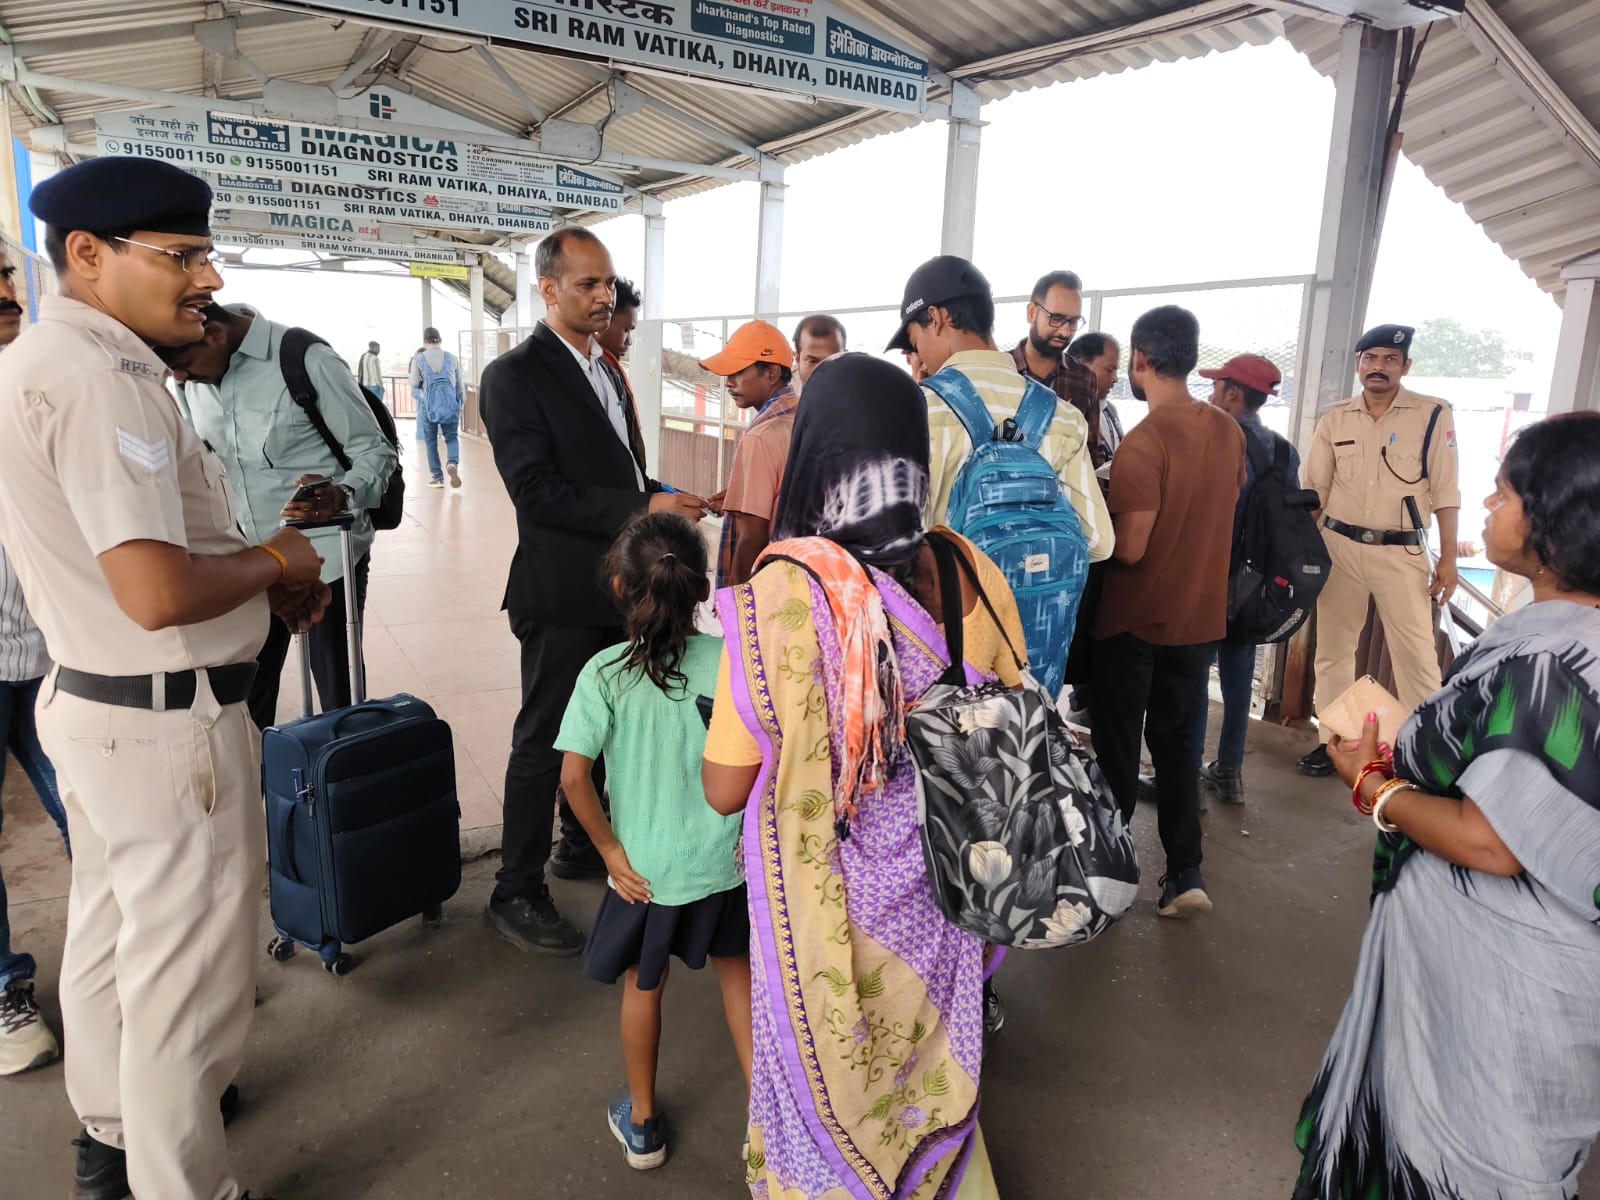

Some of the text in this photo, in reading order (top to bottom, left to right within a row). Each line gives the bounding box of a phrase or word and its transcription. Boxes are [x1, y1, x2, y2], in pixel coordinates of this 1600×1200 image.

[696, 2, 759, 24] Jharkhand's
[762, 16, 779, 30] Top
[782, 20, 811, 36] Rated
[725, 22, 784, 43] Diagnostics
[514, 7, 557, 34] SRI
[568, 17, 625, 47] RAM
[634, 30, 724, 69] VATIKA,
[733, 49, 817, 86] DHAIYA,
[825, 67, 917, 101] DHANBAD
[136, 127, 195, 142] इलाज सही
[160, 118, 181, 130] सही
[123, 142, 225, 165] 9155001150
[212, 135, 286, 151] DIAGNOSTICS
[302, 140, 458, 172] DIAGNOSTICS
[246, 157, 338, 177] 9155001151
[220, 180, 280, 191] DIAGNOSTICS
[291, 181, 417, 204] DIAGNOSTICS
[368, 169, 393, 183] SRI
[398, 173, 432, 187] RAM
[437, 177, 493, 195] VATIKA,
[497, 184, 551, 202] DHAIYA,
[556, 191, 618, 209] DHANBAD
[248, 195, 321, 210] 9155001151
[269, 212, 355, 233] MAGICA
[344, 203, 550, 231] SRI RAM VATIKA, DHAIYA, DHANBAD
[232, 236, 285, 246] 9155001151
[301, 240, 316, 249] SRI
[319, 242, 340, 251] RAM
[414, 251, 454, 261] DHANBAD
